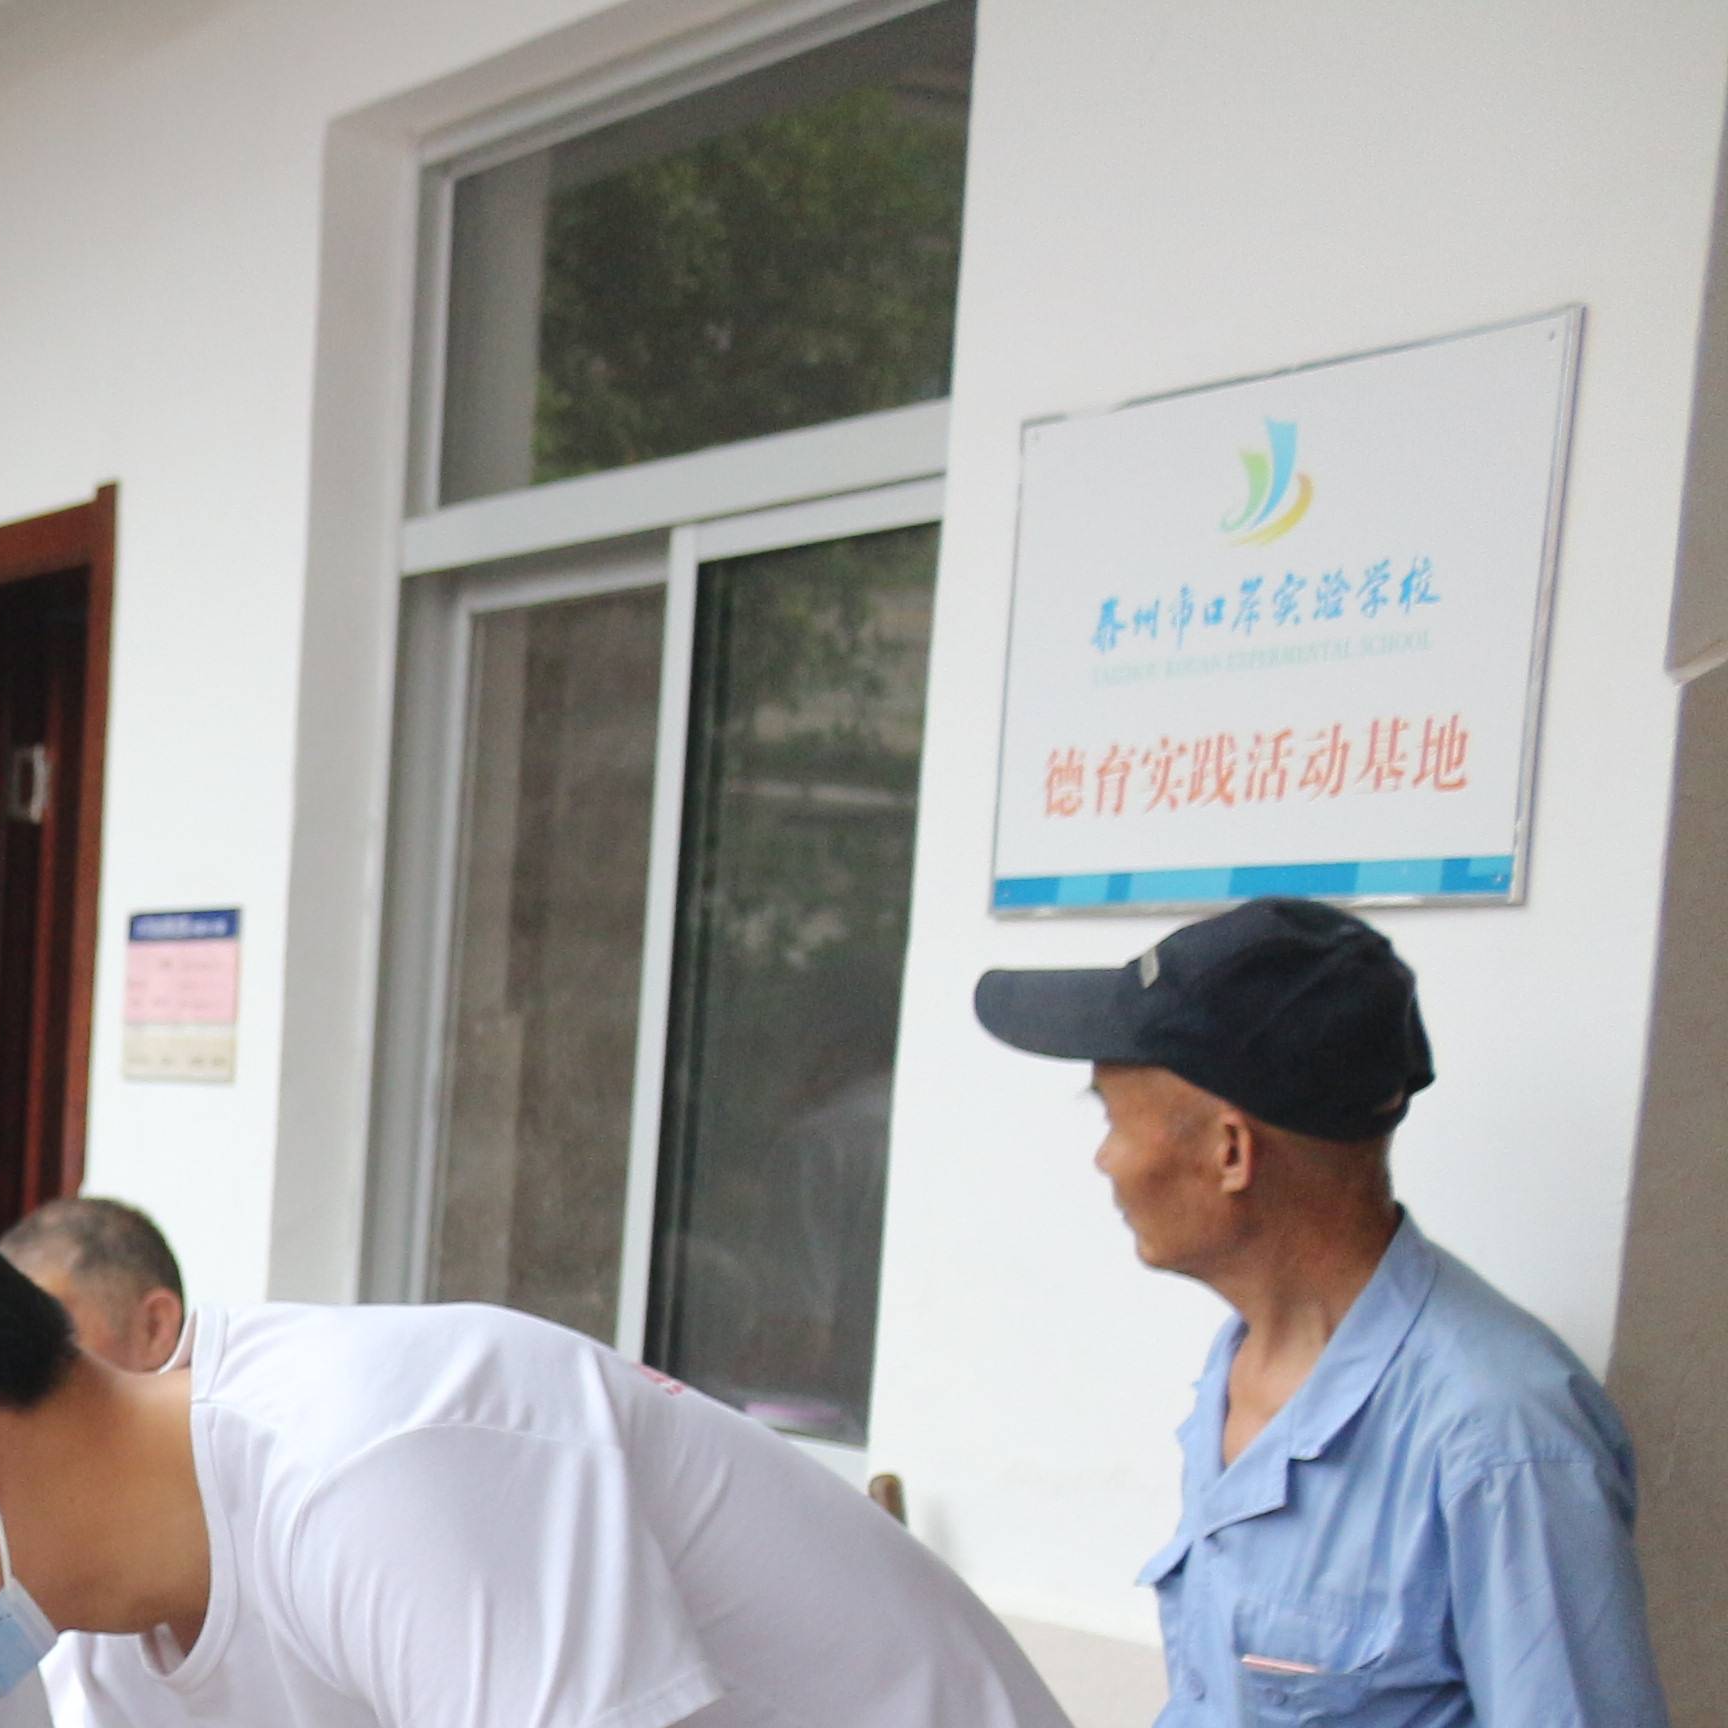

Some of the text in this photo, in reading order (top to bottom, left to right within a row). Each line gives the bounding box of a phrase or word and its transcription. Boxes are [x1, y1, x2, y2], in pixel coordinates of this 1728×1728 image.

[1044, 713, 1470, 819] 德育实践活动基地
